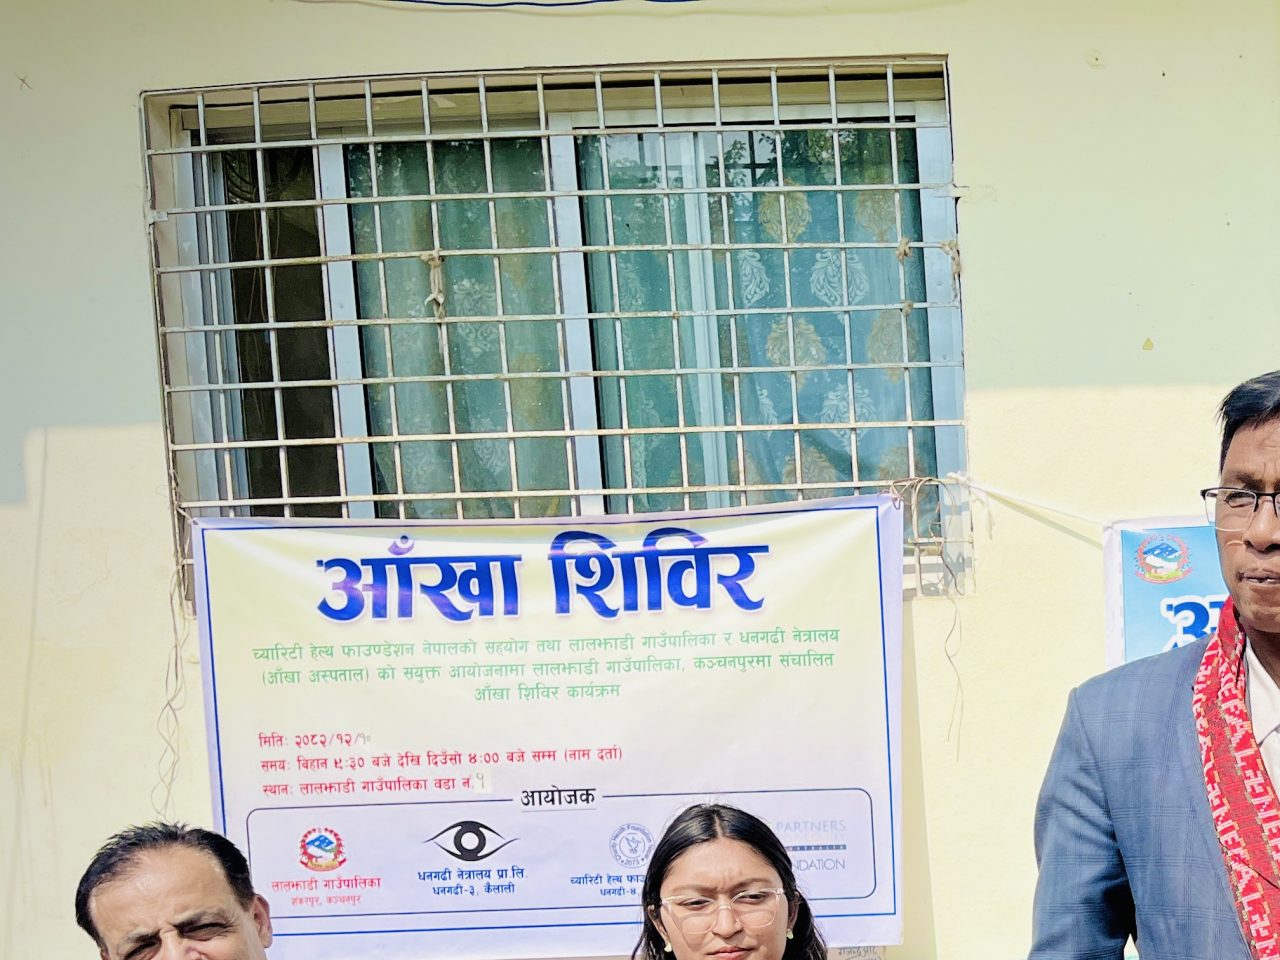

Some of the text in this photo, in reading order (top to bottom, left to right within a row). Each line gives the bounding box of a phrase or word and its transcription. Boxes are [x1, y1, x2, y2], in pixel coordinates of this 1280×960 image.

[316, 527, 769, 622] आँखा शिविर
[253, 626, 840, 661] च्यारिटी हेल्थ फाउण्डेशन नेपालको सहयोग तथा लालझाडी गाउँपालिका र धनगढी नेत्रालय
[262, 649, 835, 687] (आँखा अस्पताल) को संयुक्त आयोजनामा लालझाडी गाउँपालिका, कञ्चनपुरमा संचालित
[474, 680, 621, 701] आँखा शिविर कार्यक्रम
[259, 732, 289, 749] मिति:
[261, 758, 290, 773] समय:
[297, 755, 328, 771] बिहान
[372, 753, 392, 768] बजे
[397, 751, 421, 769] देखि
[427, 749, 462, 767] दिउँसो
[468, 752, 499, 766] ४:००
[506, 749, 526, 764] बजे
[531, 748, 557, 763] सम्म
[563, 746, 591, 763] (नाम
[597, 744, 623, 761] दर्ता)
[262, 782, 293, 797] स्थान:
[299, 778, 355, 795] लालझाडी
[361, 775, 428, 793] गाउँपालिका
[434, 778, 456, 790] वडा
[521, 785, 596, 807] आयोजक
[777, 819, 847, 834] PARTNERS
[417, 868, 452, 882] धनगढी
[457, 867, 492, 881] नेत्रालय
[792, 858, 846, 872] NDATION
[323, 873, 382, 890] गाउँपालिका
[484, 881, 515, 895] कैलाली
[570, 872, 602, 886] च्यारिटी
